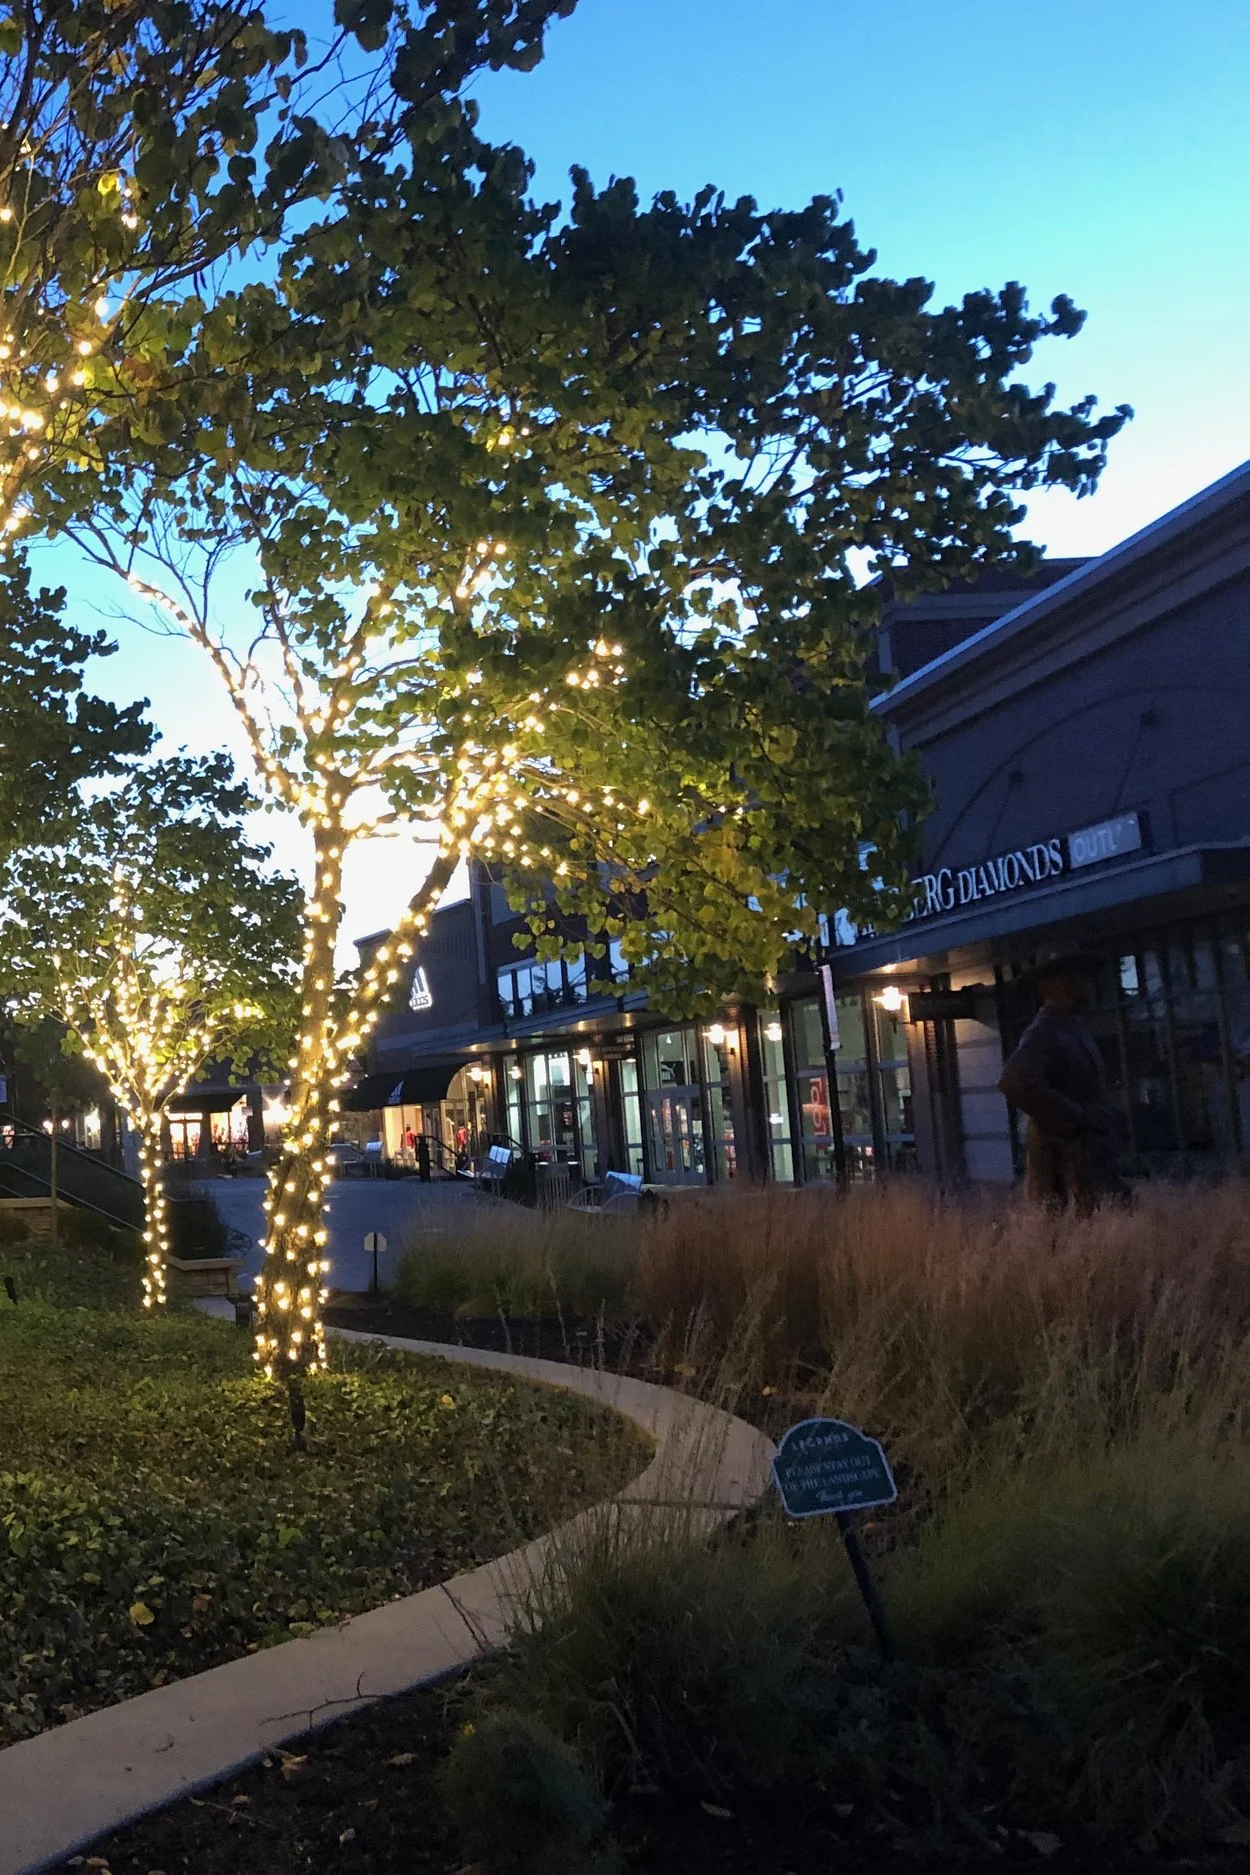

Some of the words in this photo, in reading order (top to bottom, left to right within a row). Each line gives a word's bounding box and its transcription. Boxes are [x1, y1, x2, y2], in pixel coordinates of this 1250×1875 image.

[957, 837, 1063, 905] DIAMONDS
[1074, 822, 1136, 862] OUTL
[823, 1458, 848, 1470] STAY
[850, 1455, 870, 1468] OUT
[802, 1478, 819, 1490] THE
